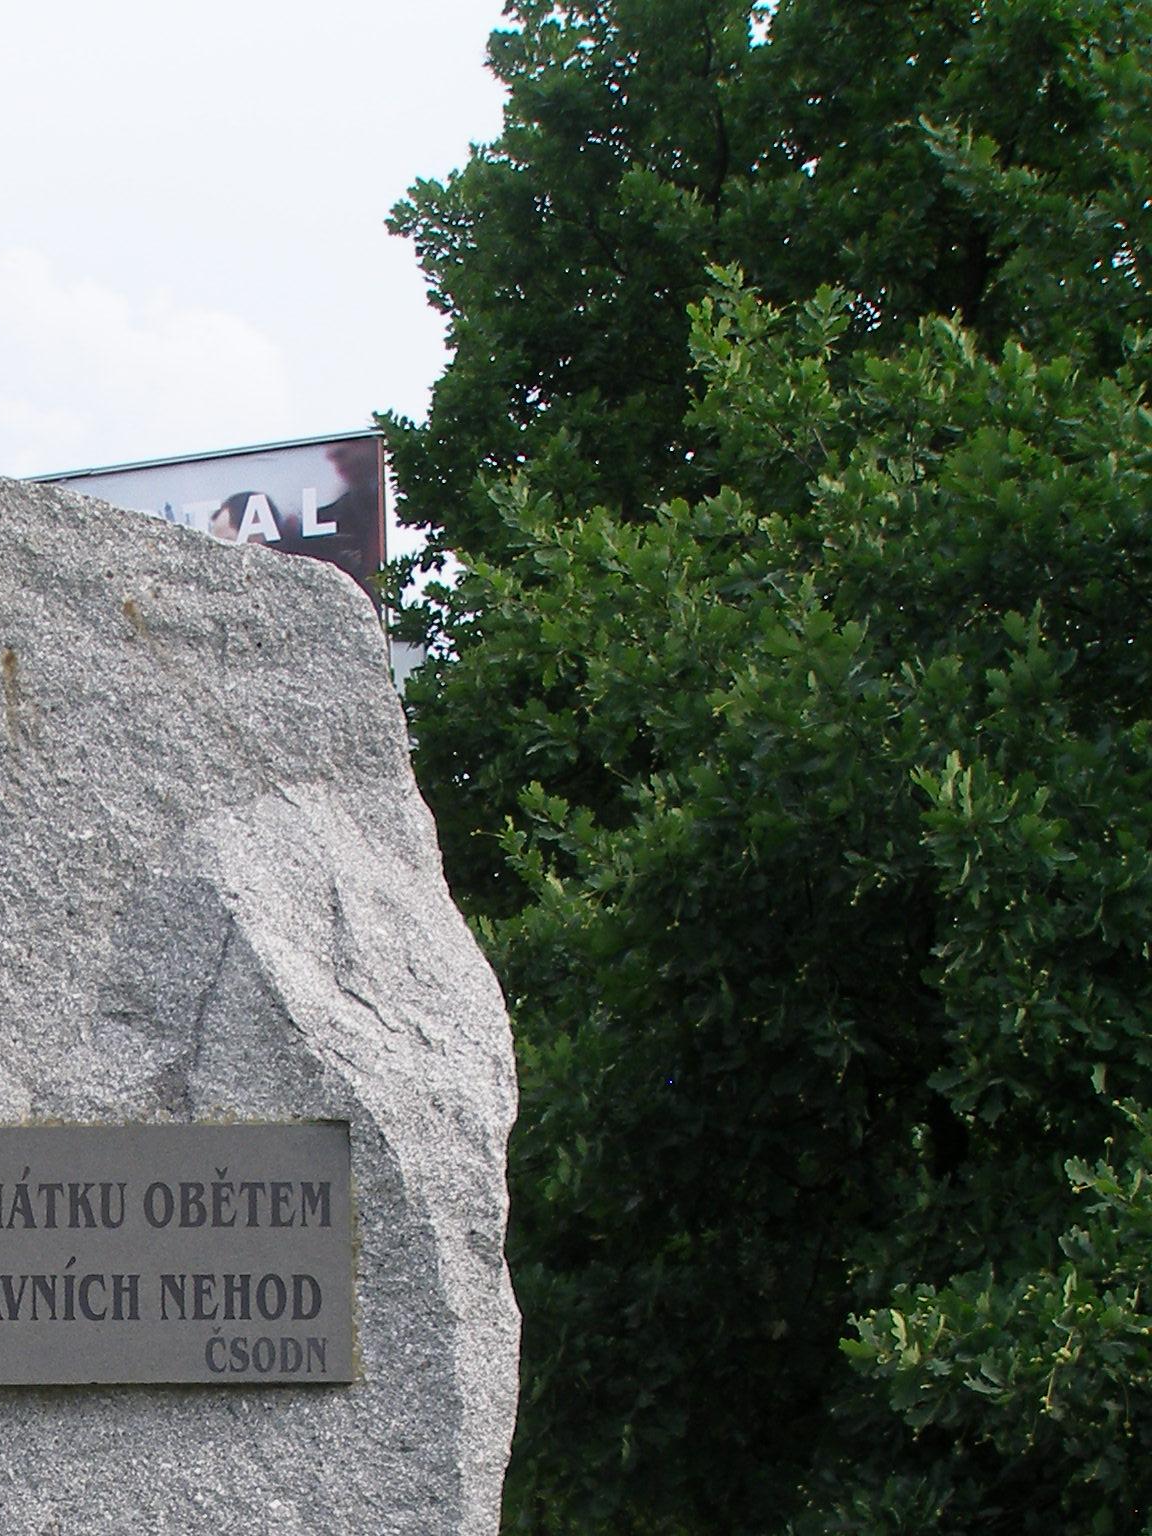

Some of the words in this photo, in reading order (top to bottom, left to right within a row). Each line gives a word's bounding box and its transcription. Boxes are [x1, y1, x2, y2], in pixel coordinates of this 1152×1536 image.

[143, 1167, 332, 1228] OBĚTEM
[160, 1273, 323, 1321] NEHOD
[204, 1326, 328, 1373] ČSODN
